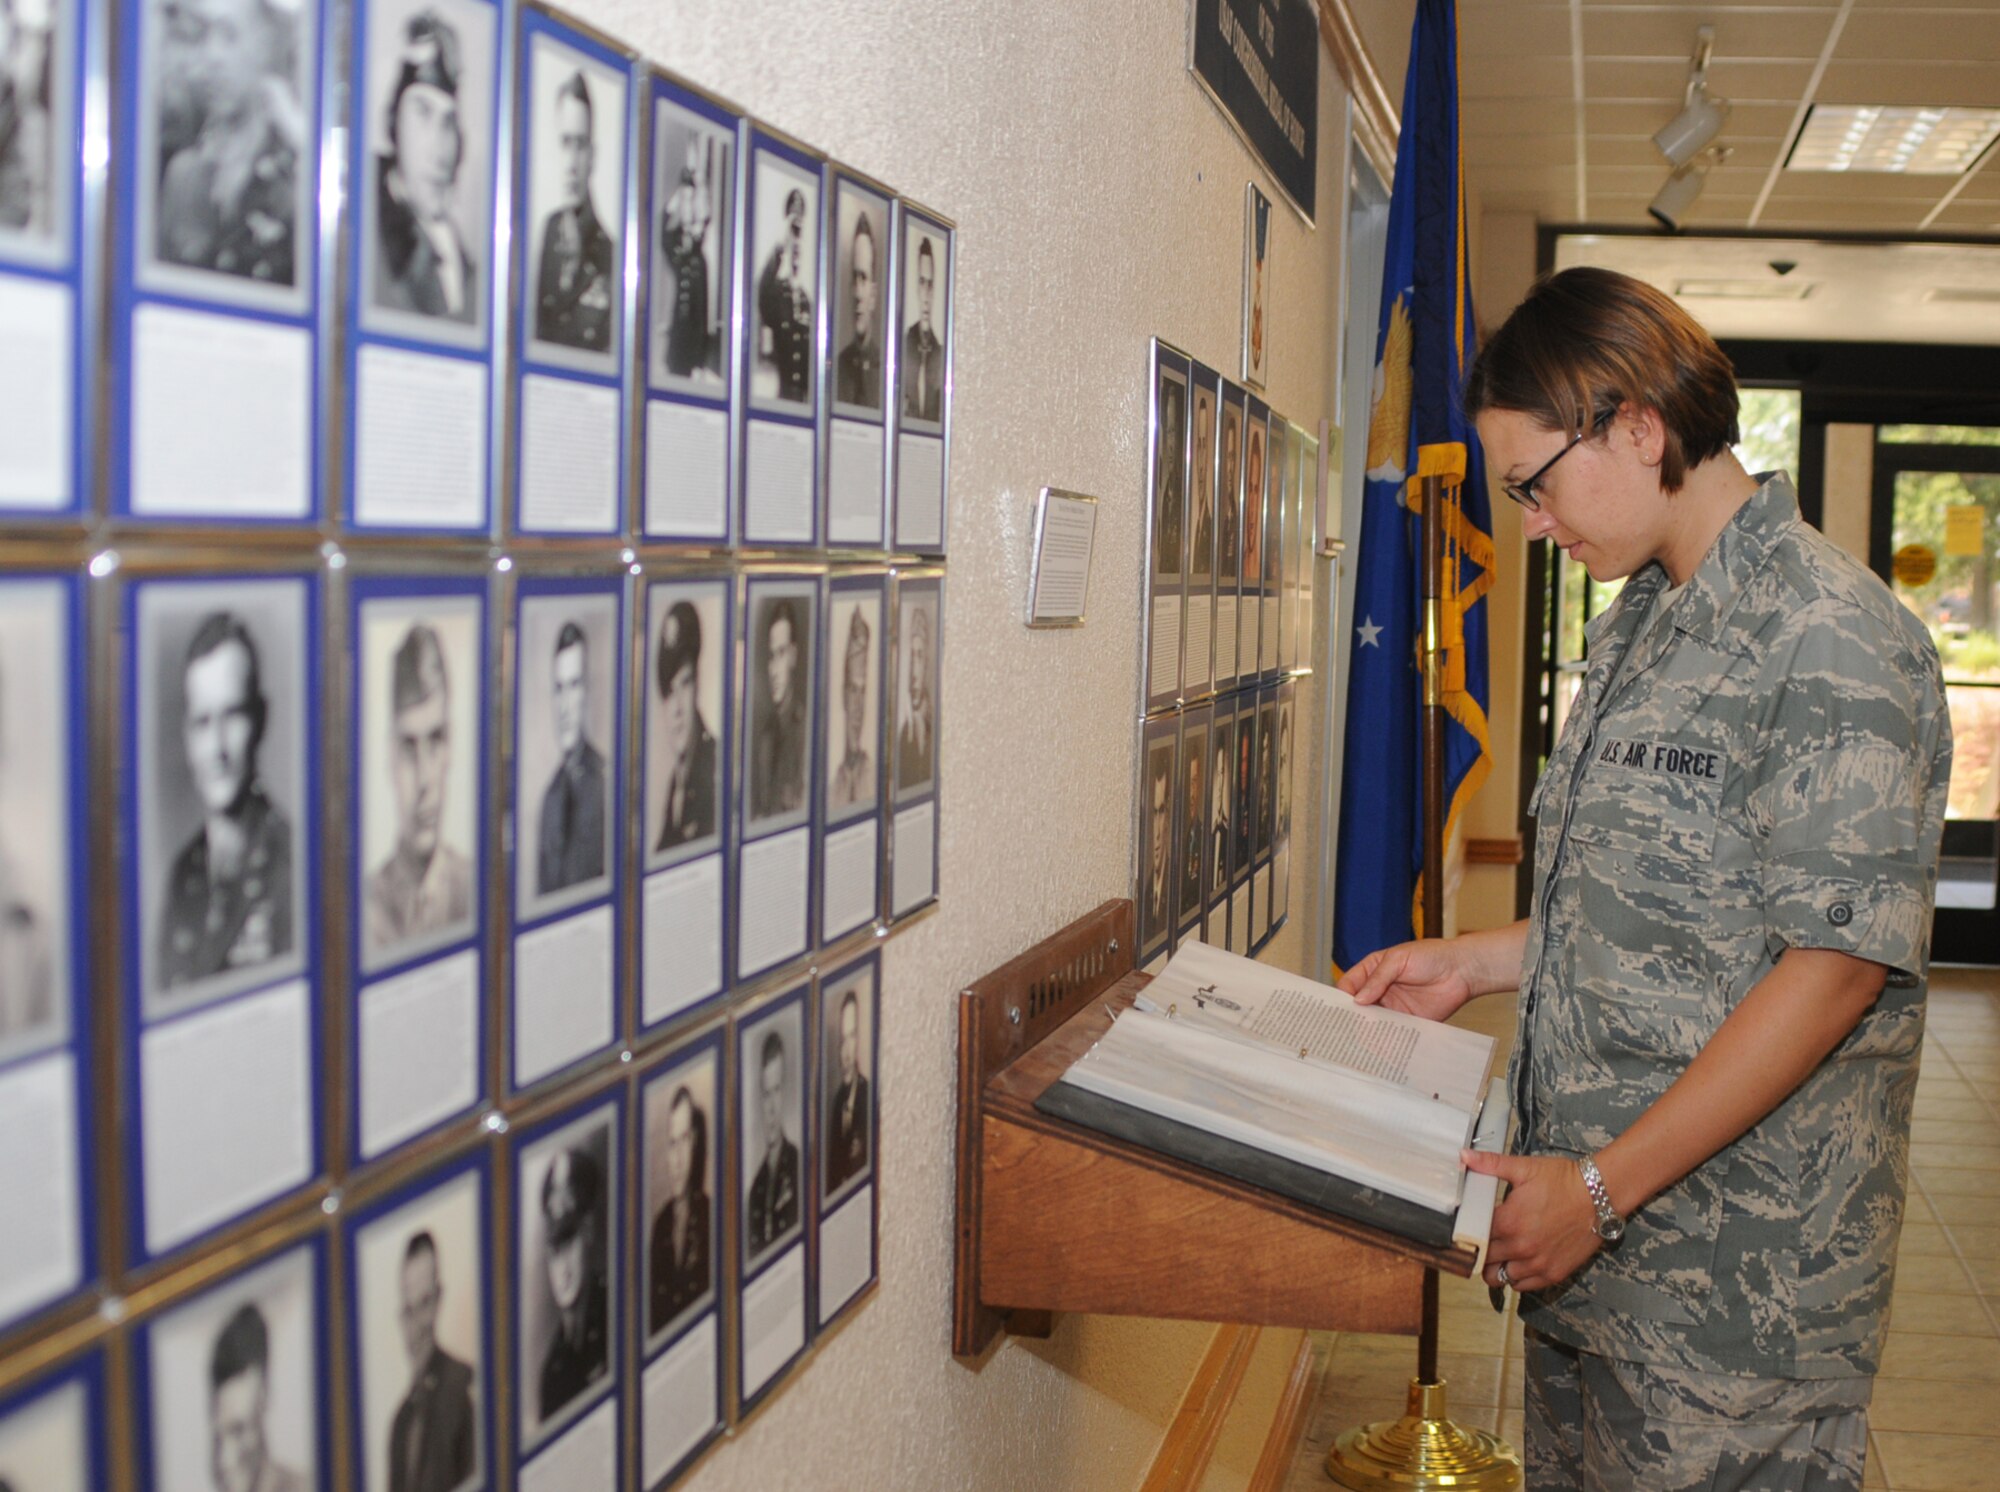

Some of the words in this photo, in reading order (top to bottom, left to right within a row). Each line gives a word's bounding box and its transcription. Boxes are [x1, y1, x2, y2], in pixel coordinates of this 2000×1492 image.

[1600, 740, 1621, 764] U.S.
[1622, 741, 1647, 768] AIR
[1653, 747, 1719, 778] FORCE
